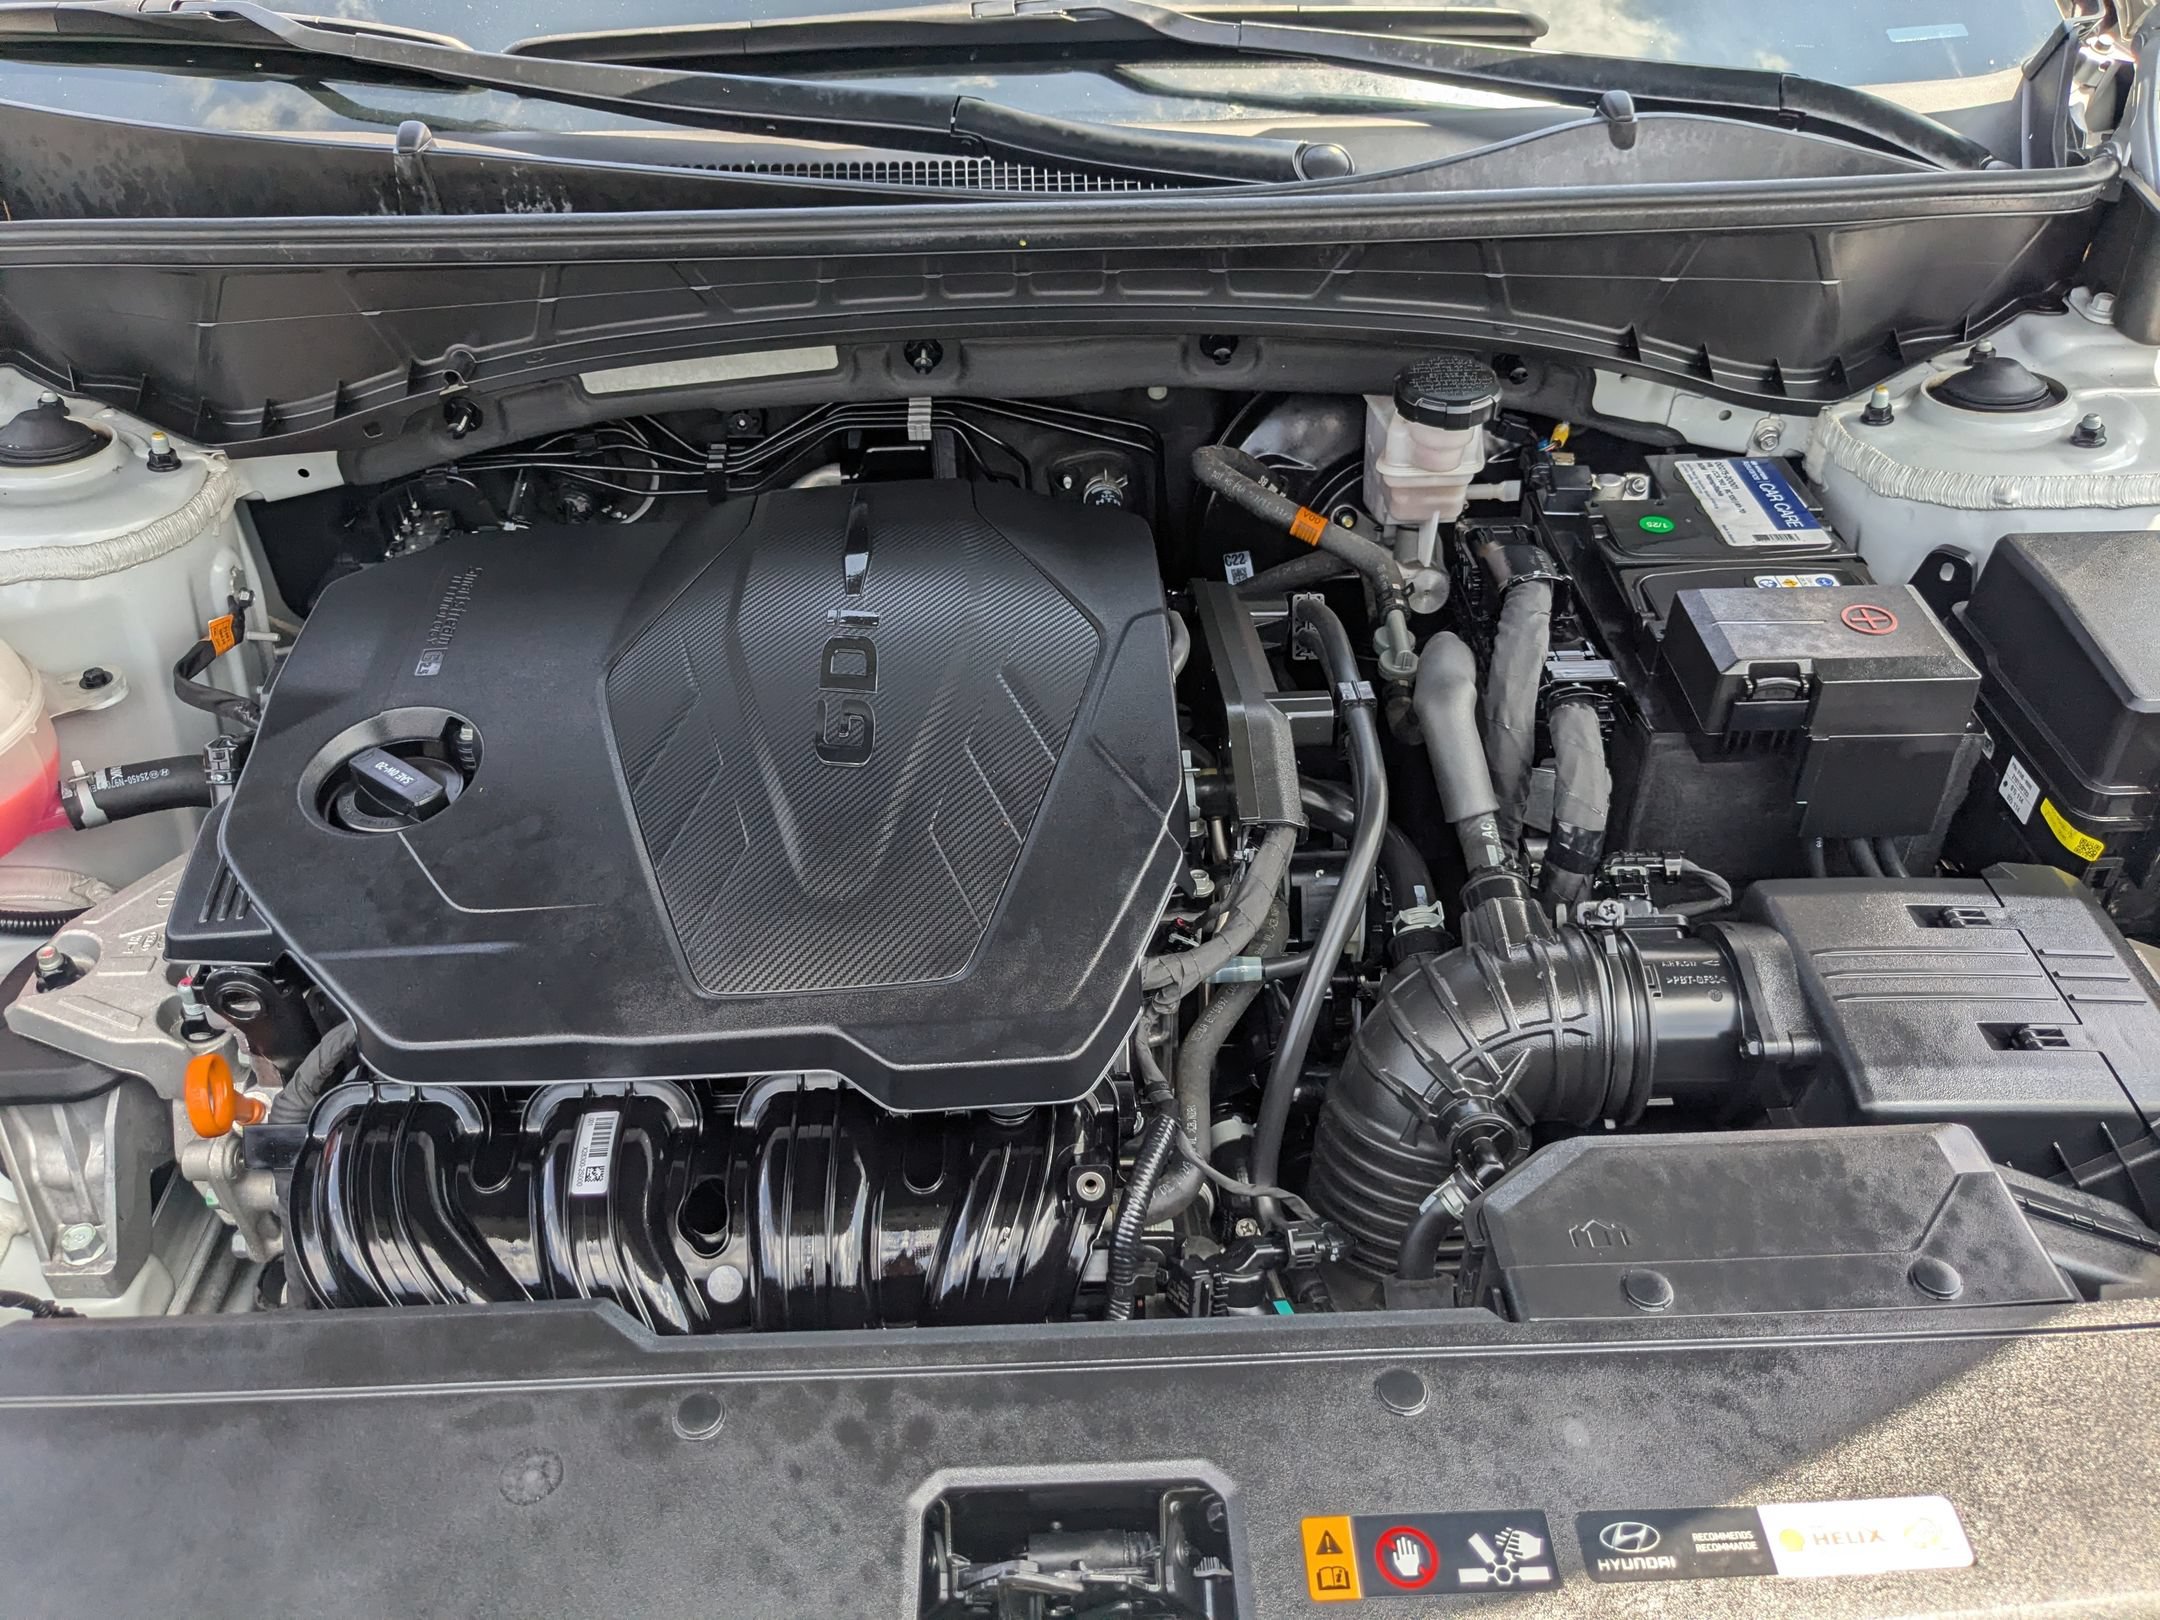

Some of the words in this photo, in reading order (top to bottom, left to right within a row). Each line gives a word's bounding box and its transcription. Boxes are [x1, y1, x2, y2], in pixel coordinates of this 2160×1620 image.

[1758, 482, 1784, 501] CAR
[1773, 503, 1804, 527] CARE
[1225, 553, 1246, 567] C22
[814, 609, 880, 767] GDI
[375, 761, 399, 777] 0W-20
[395, 772, 414, 784] SAE
[1692, 1530, 1755, 1542] RECOMMENDS
[1812, 1529, 1886, 1546] HELIX
[1695, 1541, 1758, 1553] RECOMMANDE
[1597, 1556, 1677, 1572] HYUNDAI
